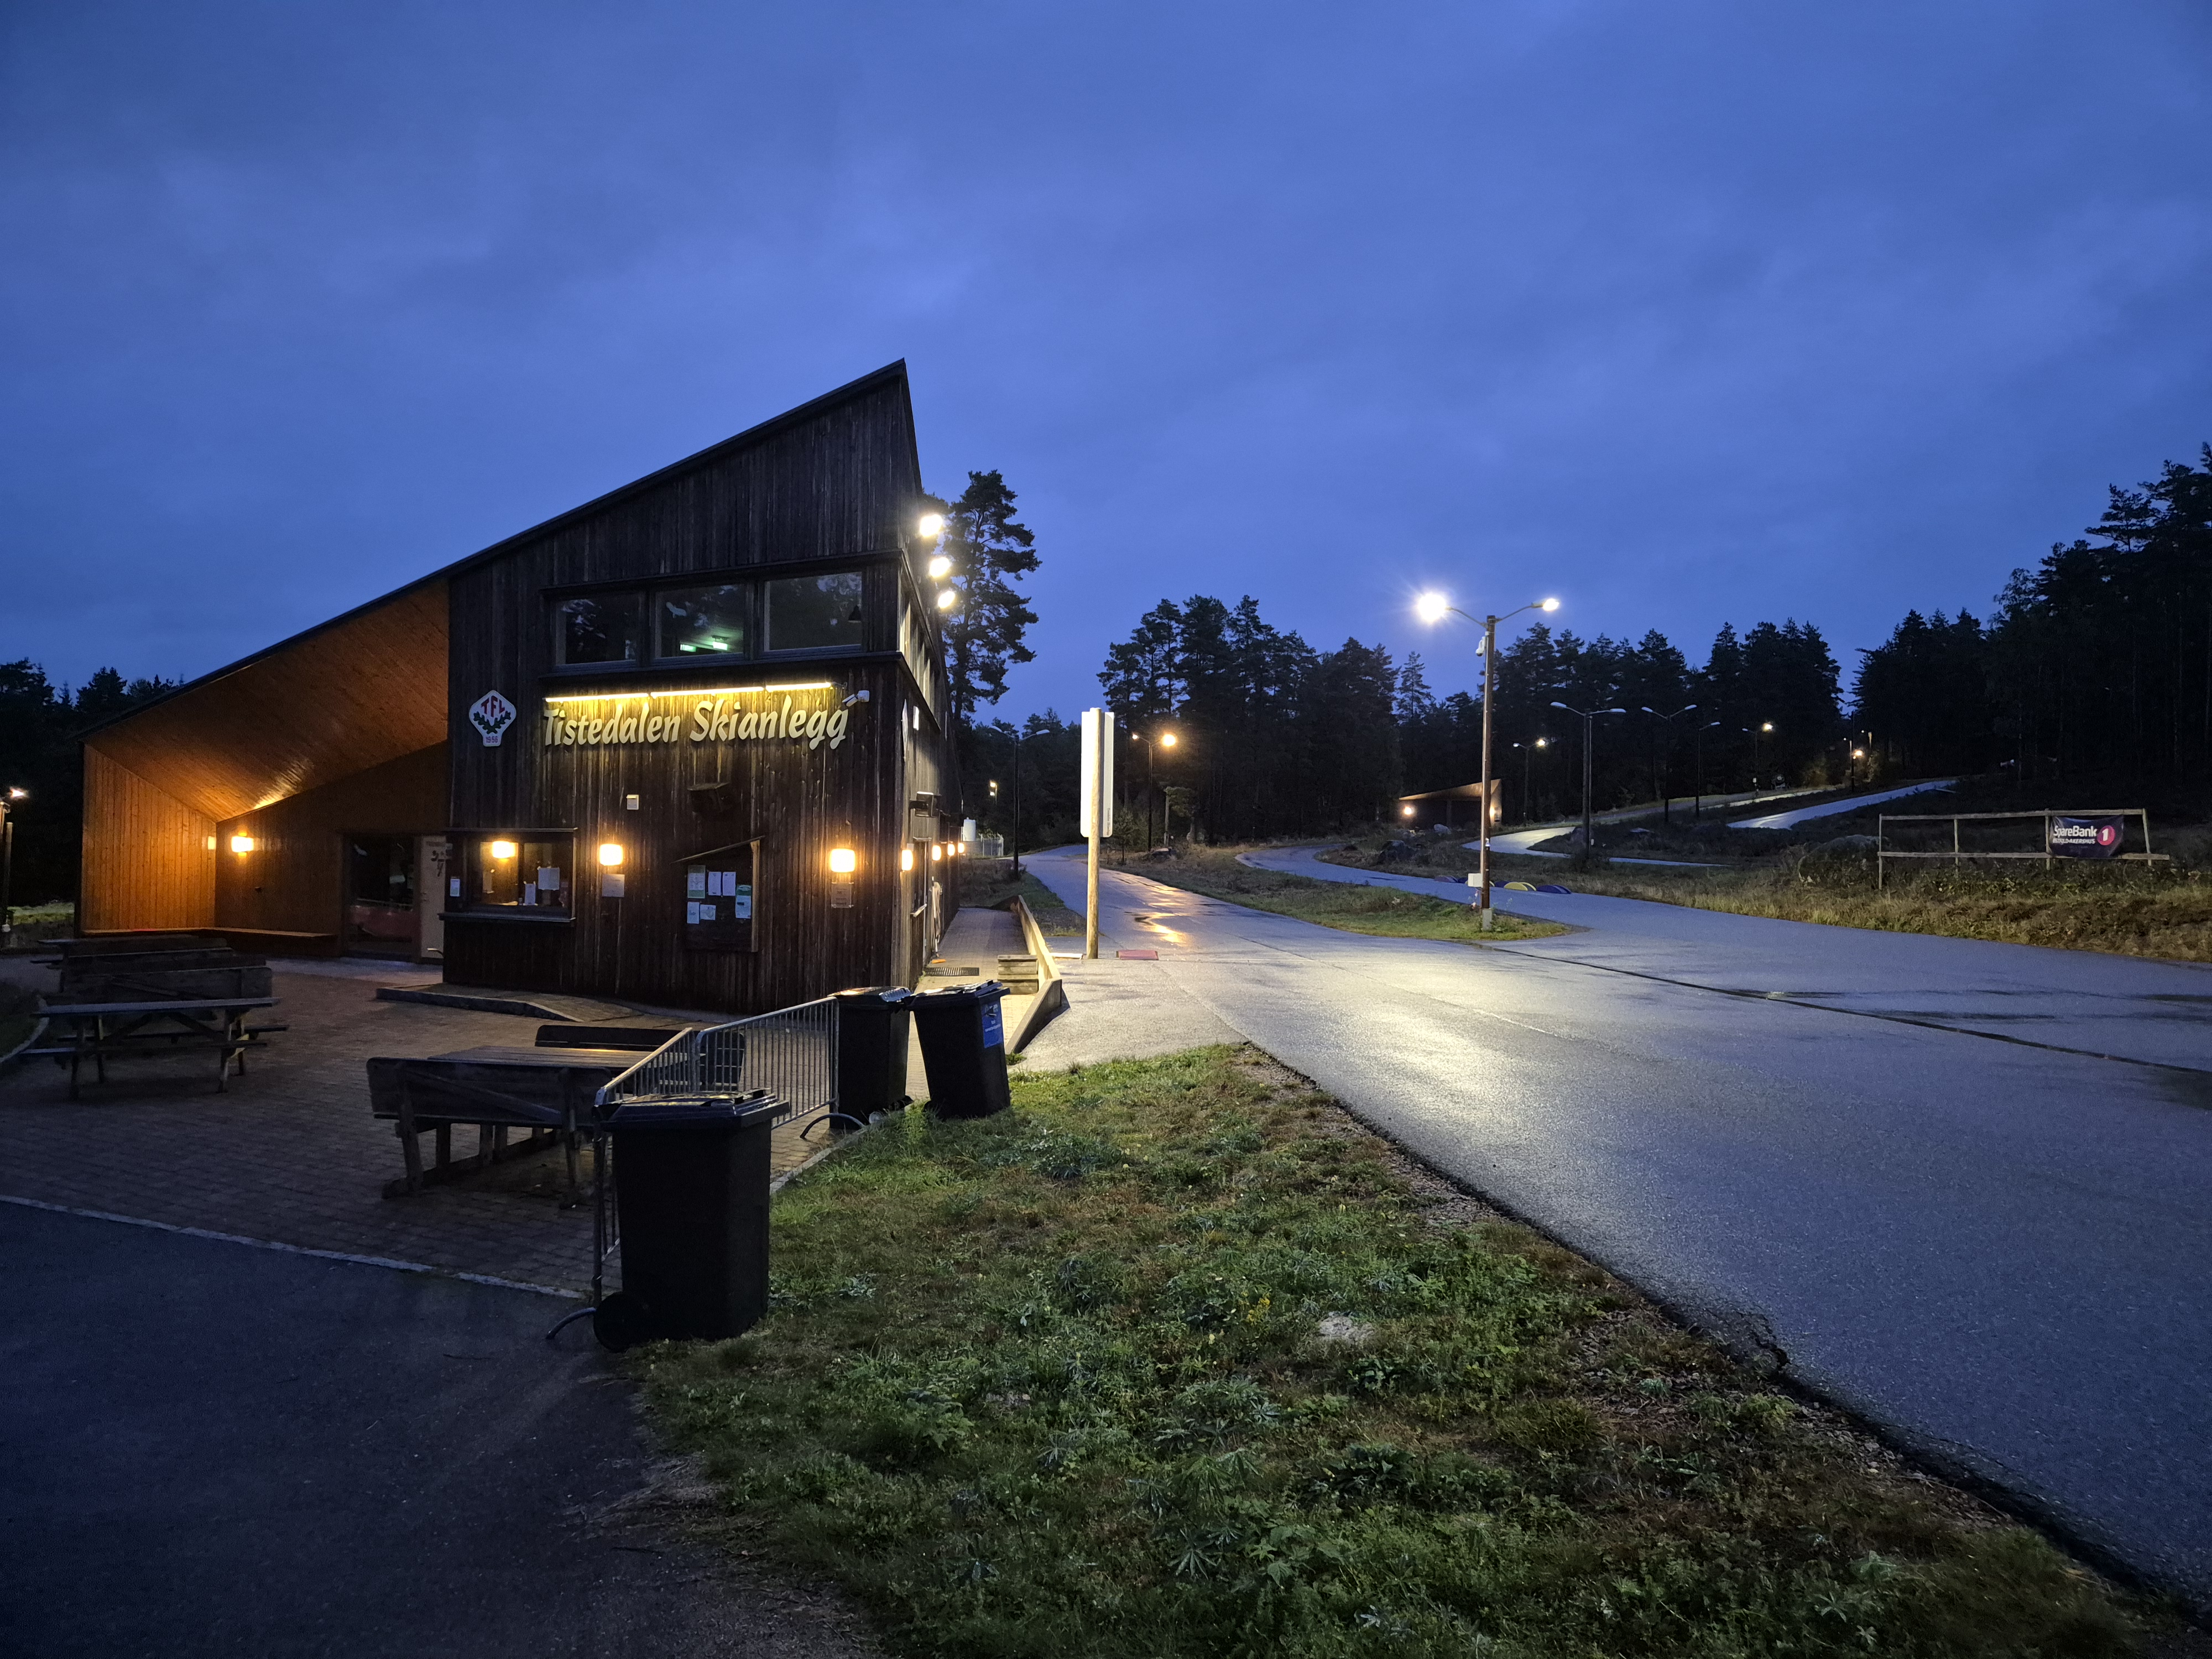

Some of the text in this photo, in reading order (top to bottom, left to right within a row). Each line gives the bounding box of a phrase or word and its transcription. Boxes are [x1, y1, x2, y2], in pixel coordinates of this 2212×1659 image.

[481, 695, 505, 717] TFL
[544, 695, 849, 750] Tistedalen Skianlegg
[2053, 825, 2109, 841] SpareBank 1
